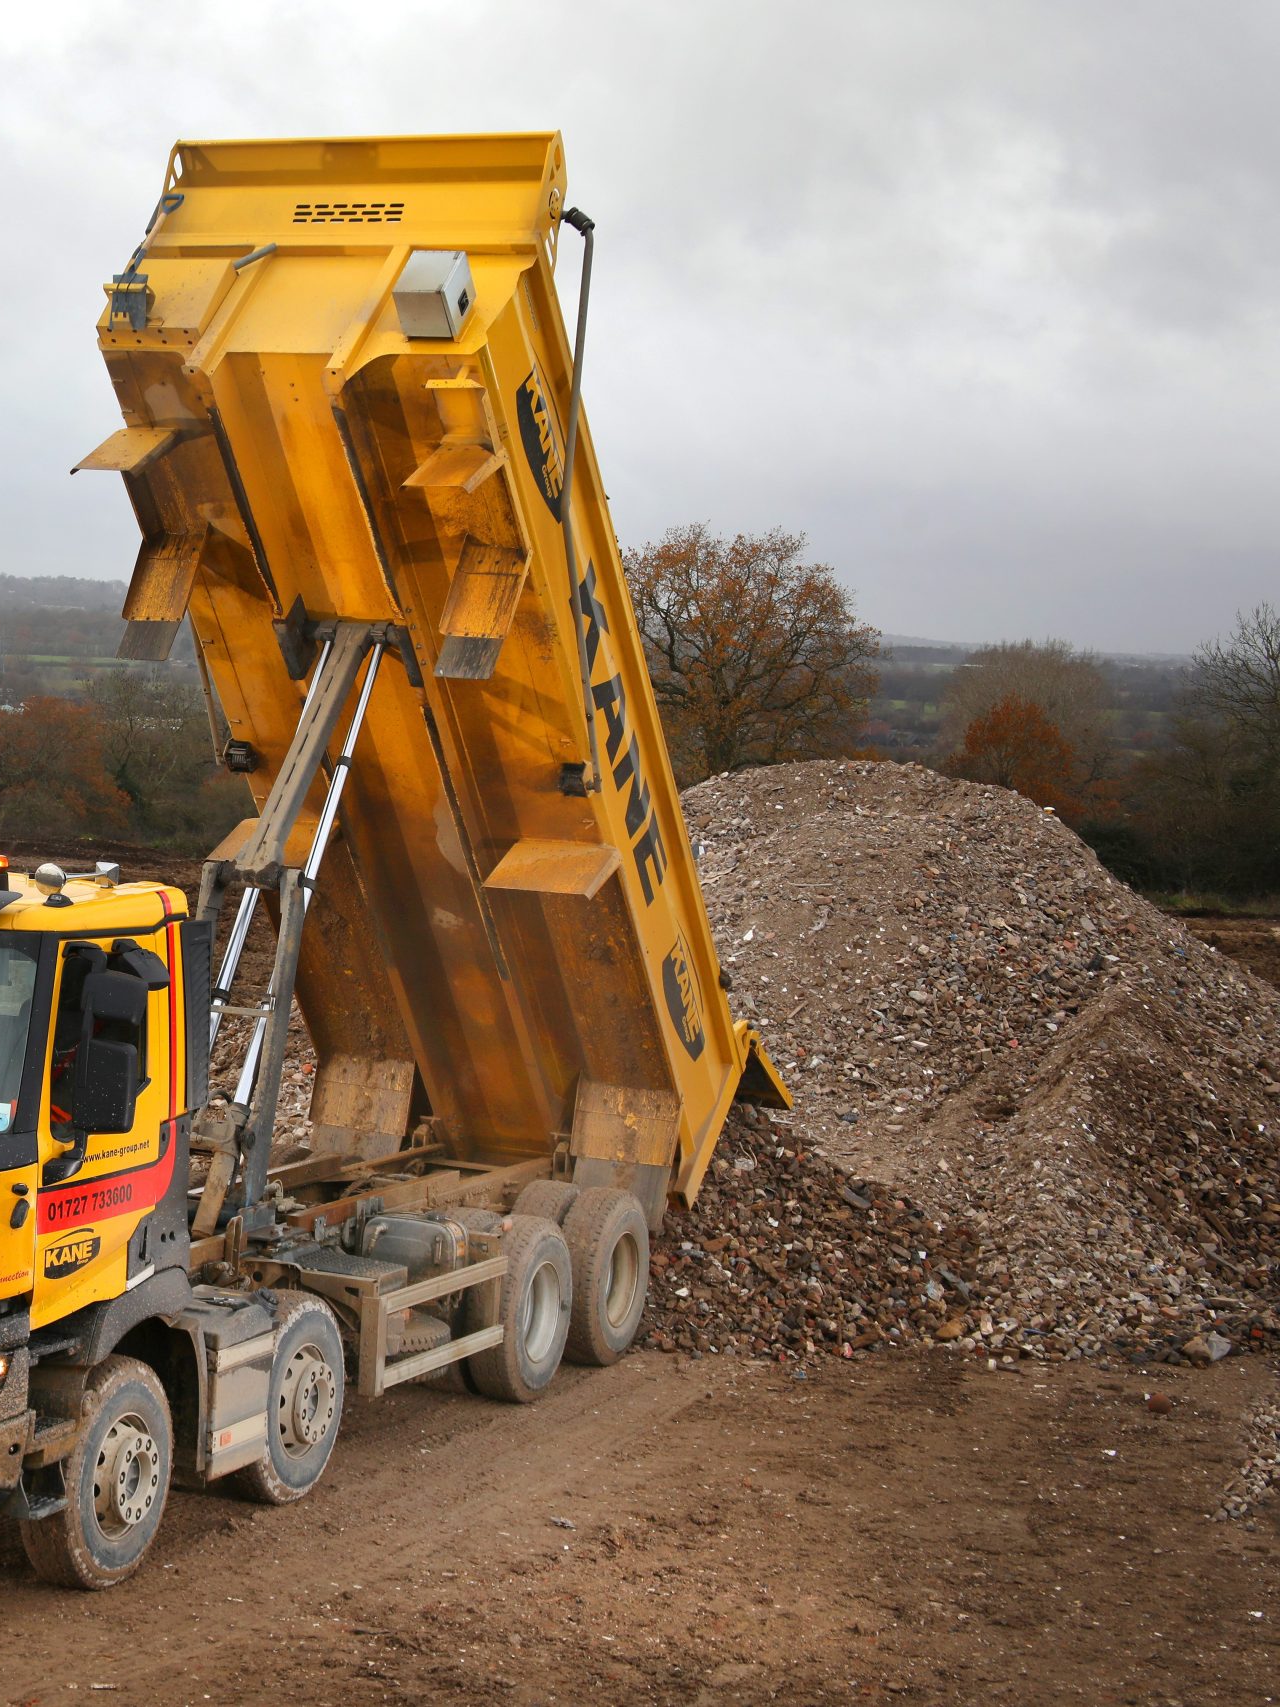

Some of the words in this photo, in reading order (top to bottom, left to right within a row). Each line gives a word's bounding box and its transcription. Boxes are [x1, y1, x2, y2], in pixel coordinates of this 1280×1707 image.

[525, 365, 563, 500] KANE
[569, 557, 668, 907] KANE
[671, 940, 700, 1043] KANE
[81, 1139, 150, 1164] www.kane-group.net
[48, 1195, 88, 1221] 01727
[92, 1183, 132, 1210] 733600
[45, 1240, 93, 1269] KANE
